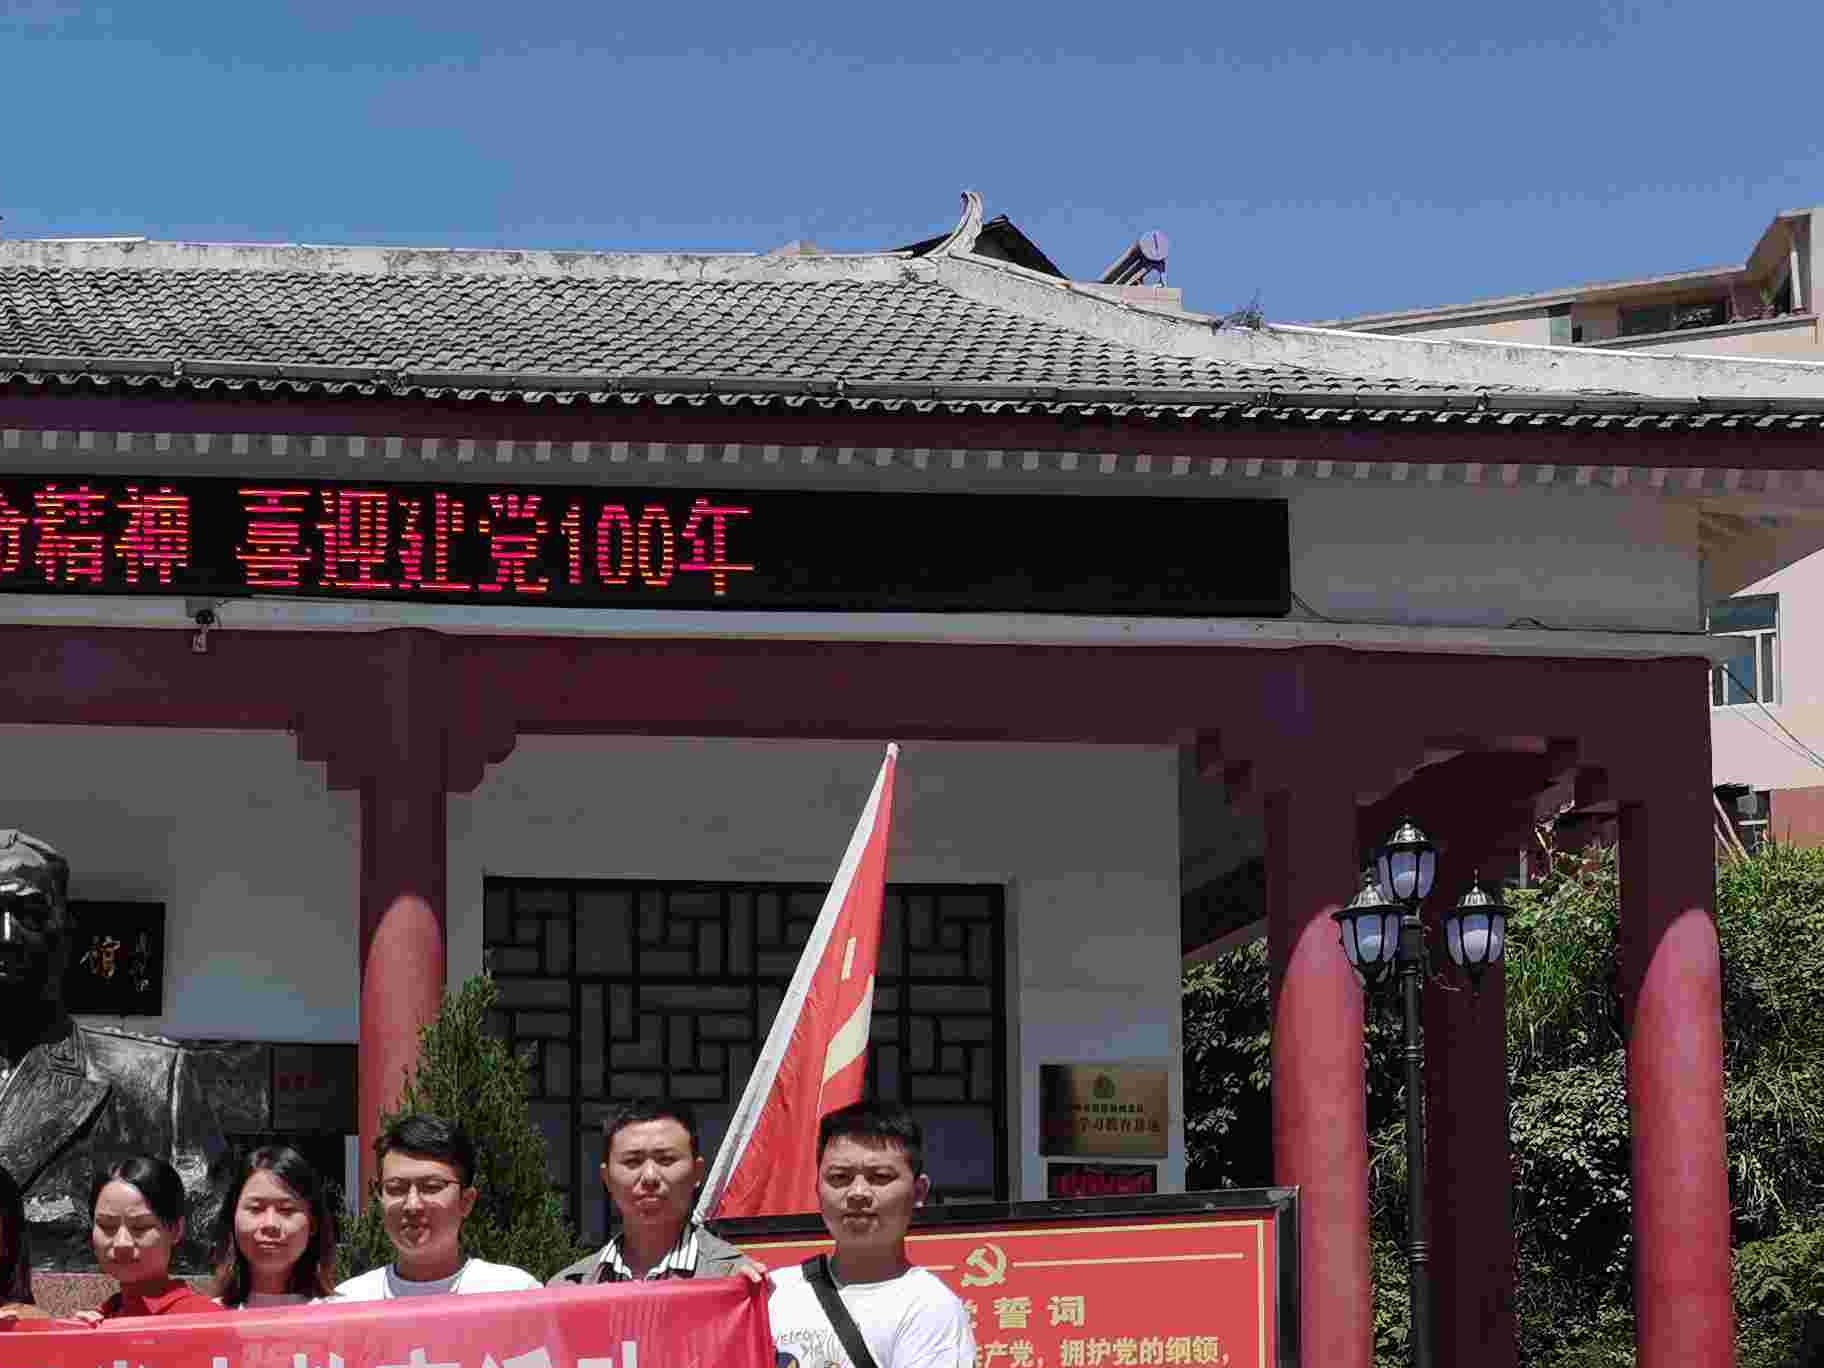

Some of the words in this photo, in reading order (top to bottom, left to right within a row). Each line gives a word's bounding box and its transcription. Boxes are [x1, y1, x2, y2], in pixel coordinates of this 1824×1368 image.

[236, 488, 755, 595] 喜迎建党100年
